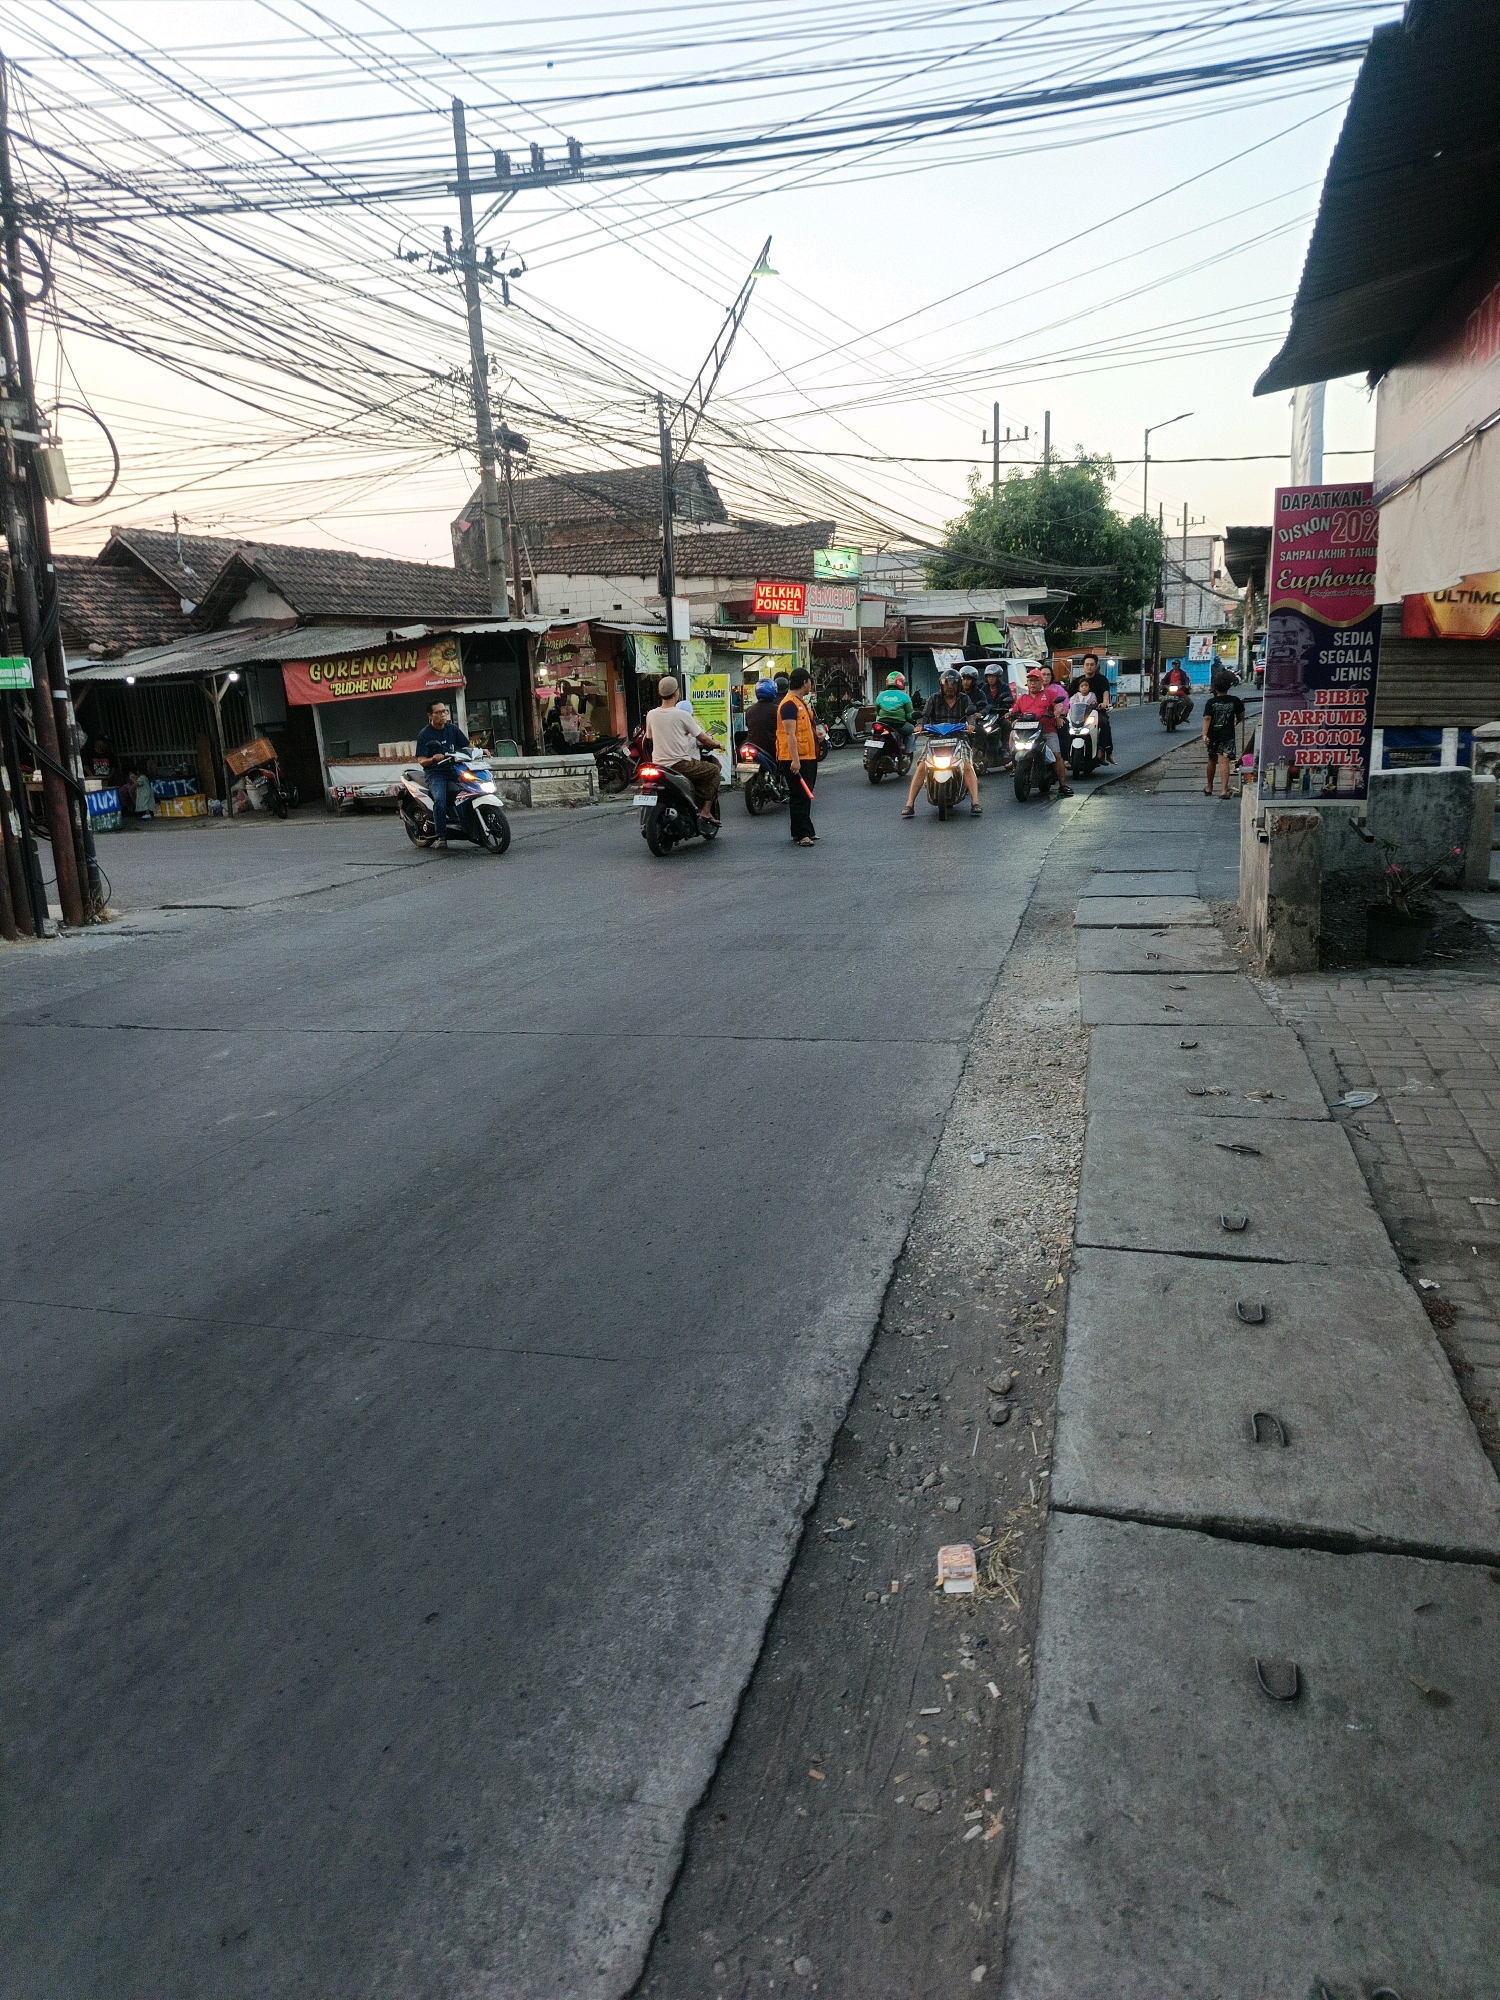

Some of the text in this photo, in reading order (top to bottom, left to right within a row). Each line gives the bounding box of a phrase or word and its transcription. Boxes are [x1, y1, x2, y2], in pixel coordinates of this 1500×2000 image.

[1277, 510, 1379, 543] DISKON 20%
[1280, 549, 1316, 561] SAMPAI
[1318, 548, 1346, 560] AKHIR
[1276, 567, 1376, 594] Euphoria
[758, 586, 801, 598] VELKHA
[810, 585, 855, 611] SERVICE HP
[757, 599, 800, 611] PONSEL
[1333, 631, 1373, 646] SEDIA
[1319, 649, 1373, 665] SEGALA
[309, 650, 418, 682] GORENGAN
[1331, 666, 1372, 681] JENIS
[692, 690, 725, 699] NUR SNACK
[1314, 689, 1368, 705] BIBIT
[1278, 708, 1367, 727] PARFUME
[1283, 729, 1364, 746] & BOTOL
[1295, 749, 1363, 767] REFILL
